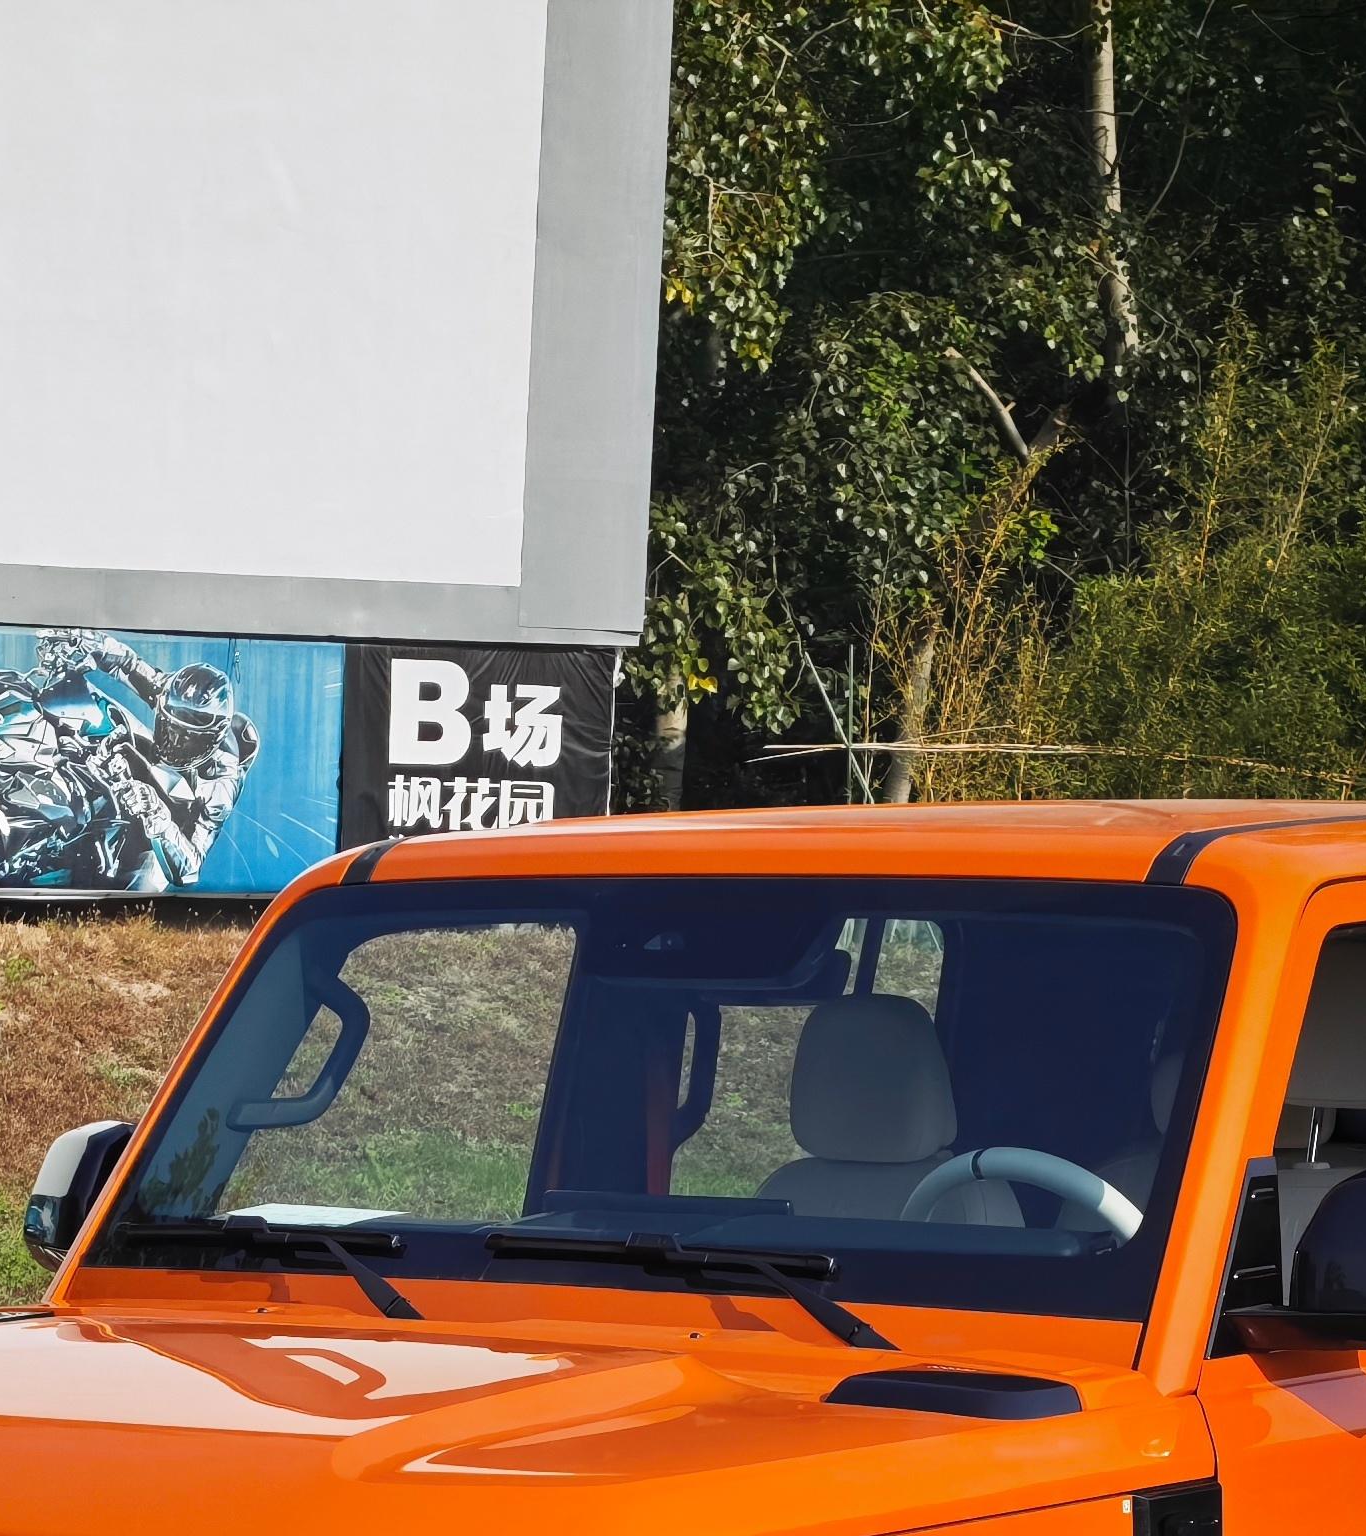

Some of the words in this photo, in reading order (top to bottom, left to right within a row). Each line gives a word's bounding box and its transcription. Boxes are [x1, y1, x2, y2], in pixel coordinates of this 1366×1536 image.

[388, 658, 563, 767] B场
[388, 774, 555, 831] 枫花园
